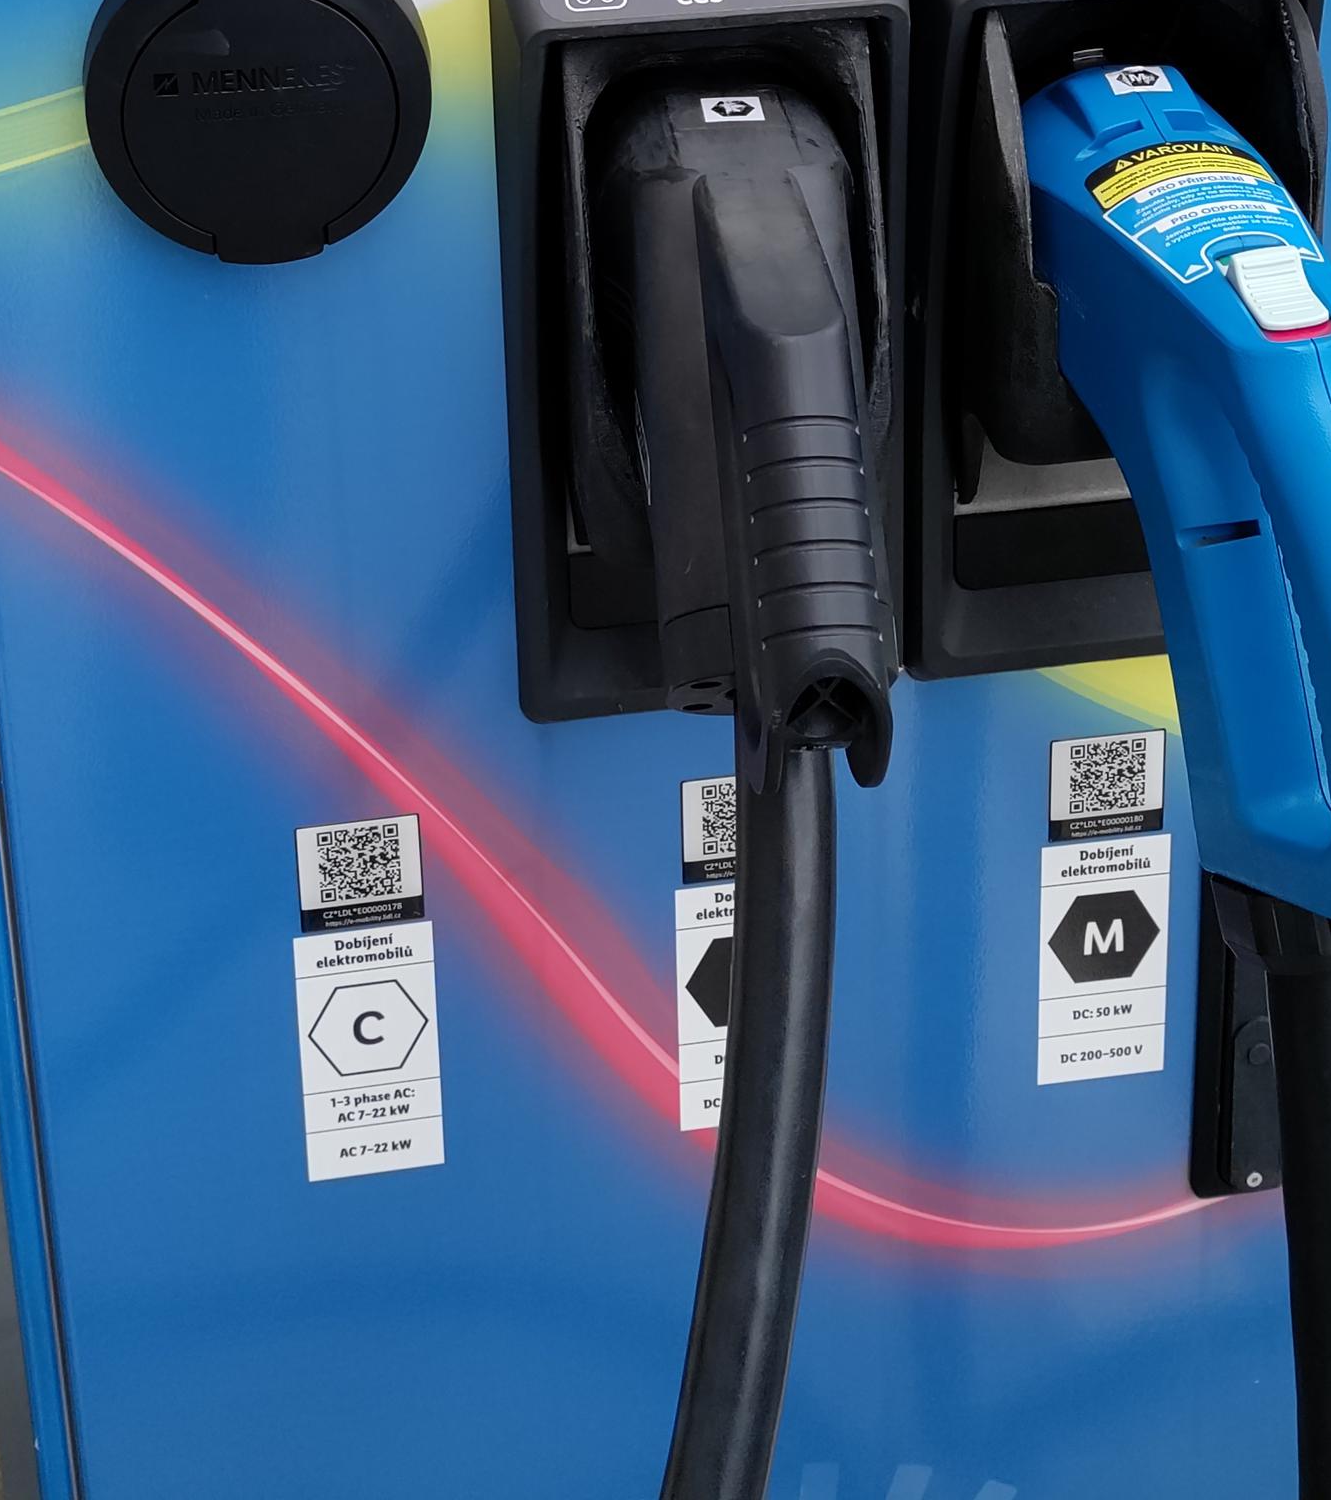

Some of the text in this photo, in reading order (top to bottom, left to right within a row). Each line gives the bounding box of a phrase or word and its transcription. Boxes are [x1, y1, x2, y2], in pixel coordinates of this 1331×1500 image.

[1148, 182, 1176, 197] PRO
[1171, 211, 1198, 225] PRO
[1079, 845, 1134, 861] Dobíjení
[1061, 858, 1151, 878] elektromobilů
[334, 933, 394, 951] Dobíjení
[1083, 918, 1125, 956] M
[316, 946, 413, 969] elektromobilů
[1072, 1004, 1133, 1020] DC: 50 kW
[353, 1010, 385, 1046] C
[1060, 1052, 1077, 1064] DC
[1134, 1044, 1143, 1055] V
[354, 1090, 391, 1107] phase
[393, 1087, 416, 1099] AC:
[338, 1111, 355, 1123] AC
[390, 1104, 410, 1116] kW
[339, 1146, 357, 1158] AC
[391, 1138, 412, 1151] kW
